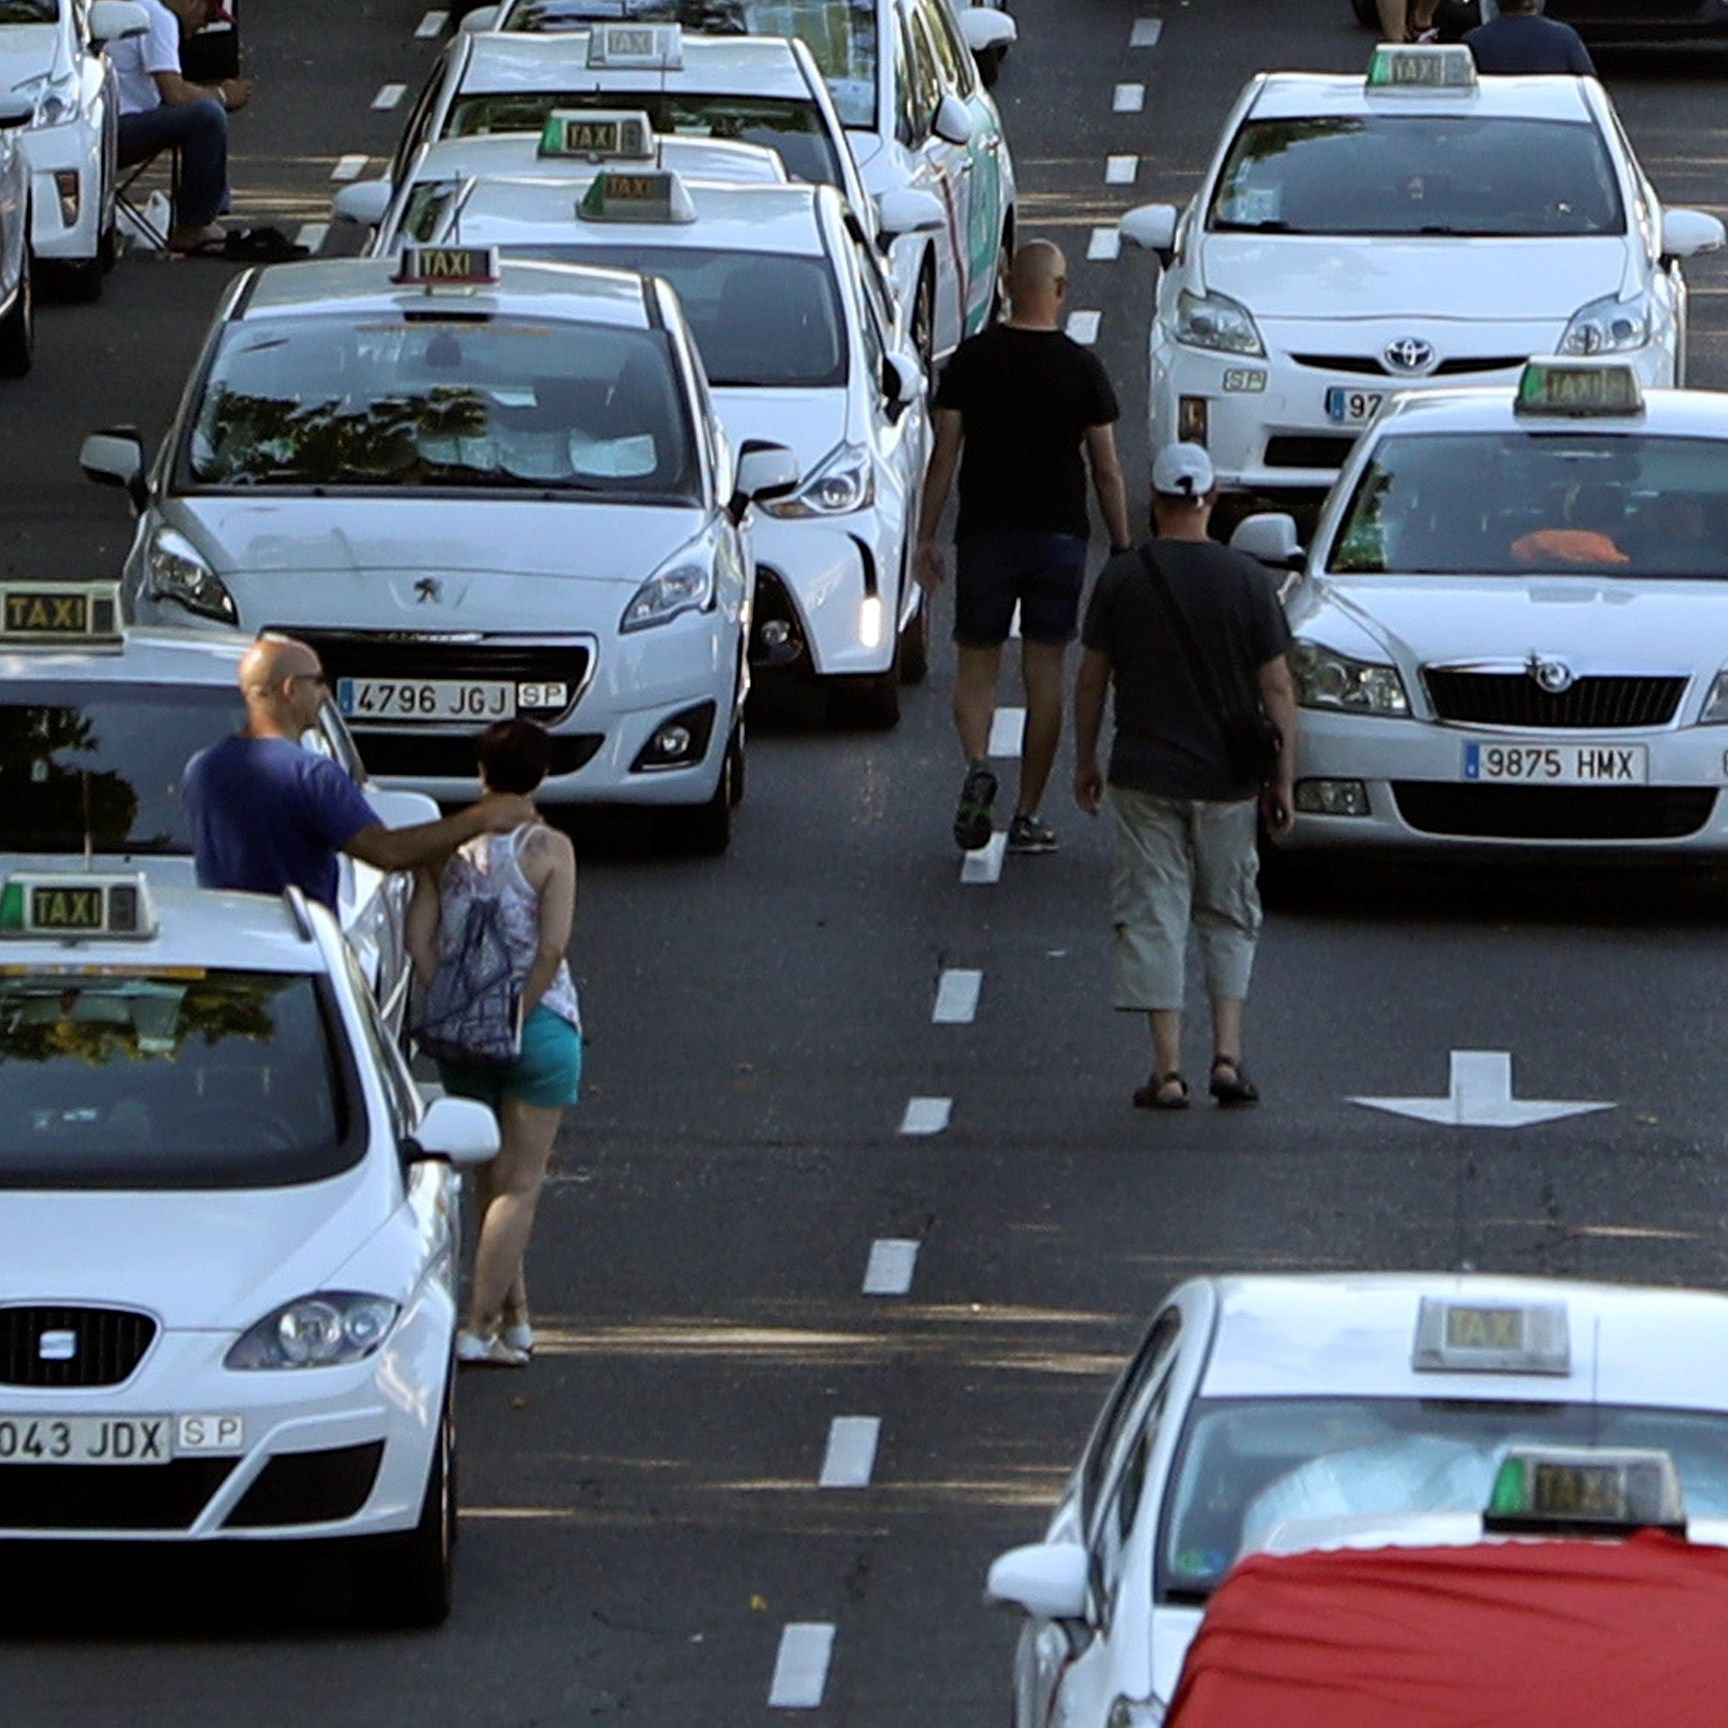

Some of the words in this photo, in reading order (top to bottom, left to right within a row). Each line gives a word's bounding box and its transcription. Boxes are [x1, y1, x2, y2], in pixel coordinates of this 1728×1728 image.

[610, 31, 649, 51] TAXI
[1395, 54, 1437, 78] TAXI
[571, 124, 613, 147] TAXI
[606, 175, 651, 195] TAXI
[425, 252, 469, 275] TAXI
[1350, 392, 1382, 419] 97
[9, 597, 85, 626] TAXI
[356, 683, 435, 714] 4796
[448, 685, 508, 716] JGJ
[520, 684, 562, 705] SP
[1487, 748, 1560, 781] 9875
[1577, 748, 1633, 781] HMX
[37, 891, 100, 923] TAXI
[86, 1420, 161, 1458] JDX
